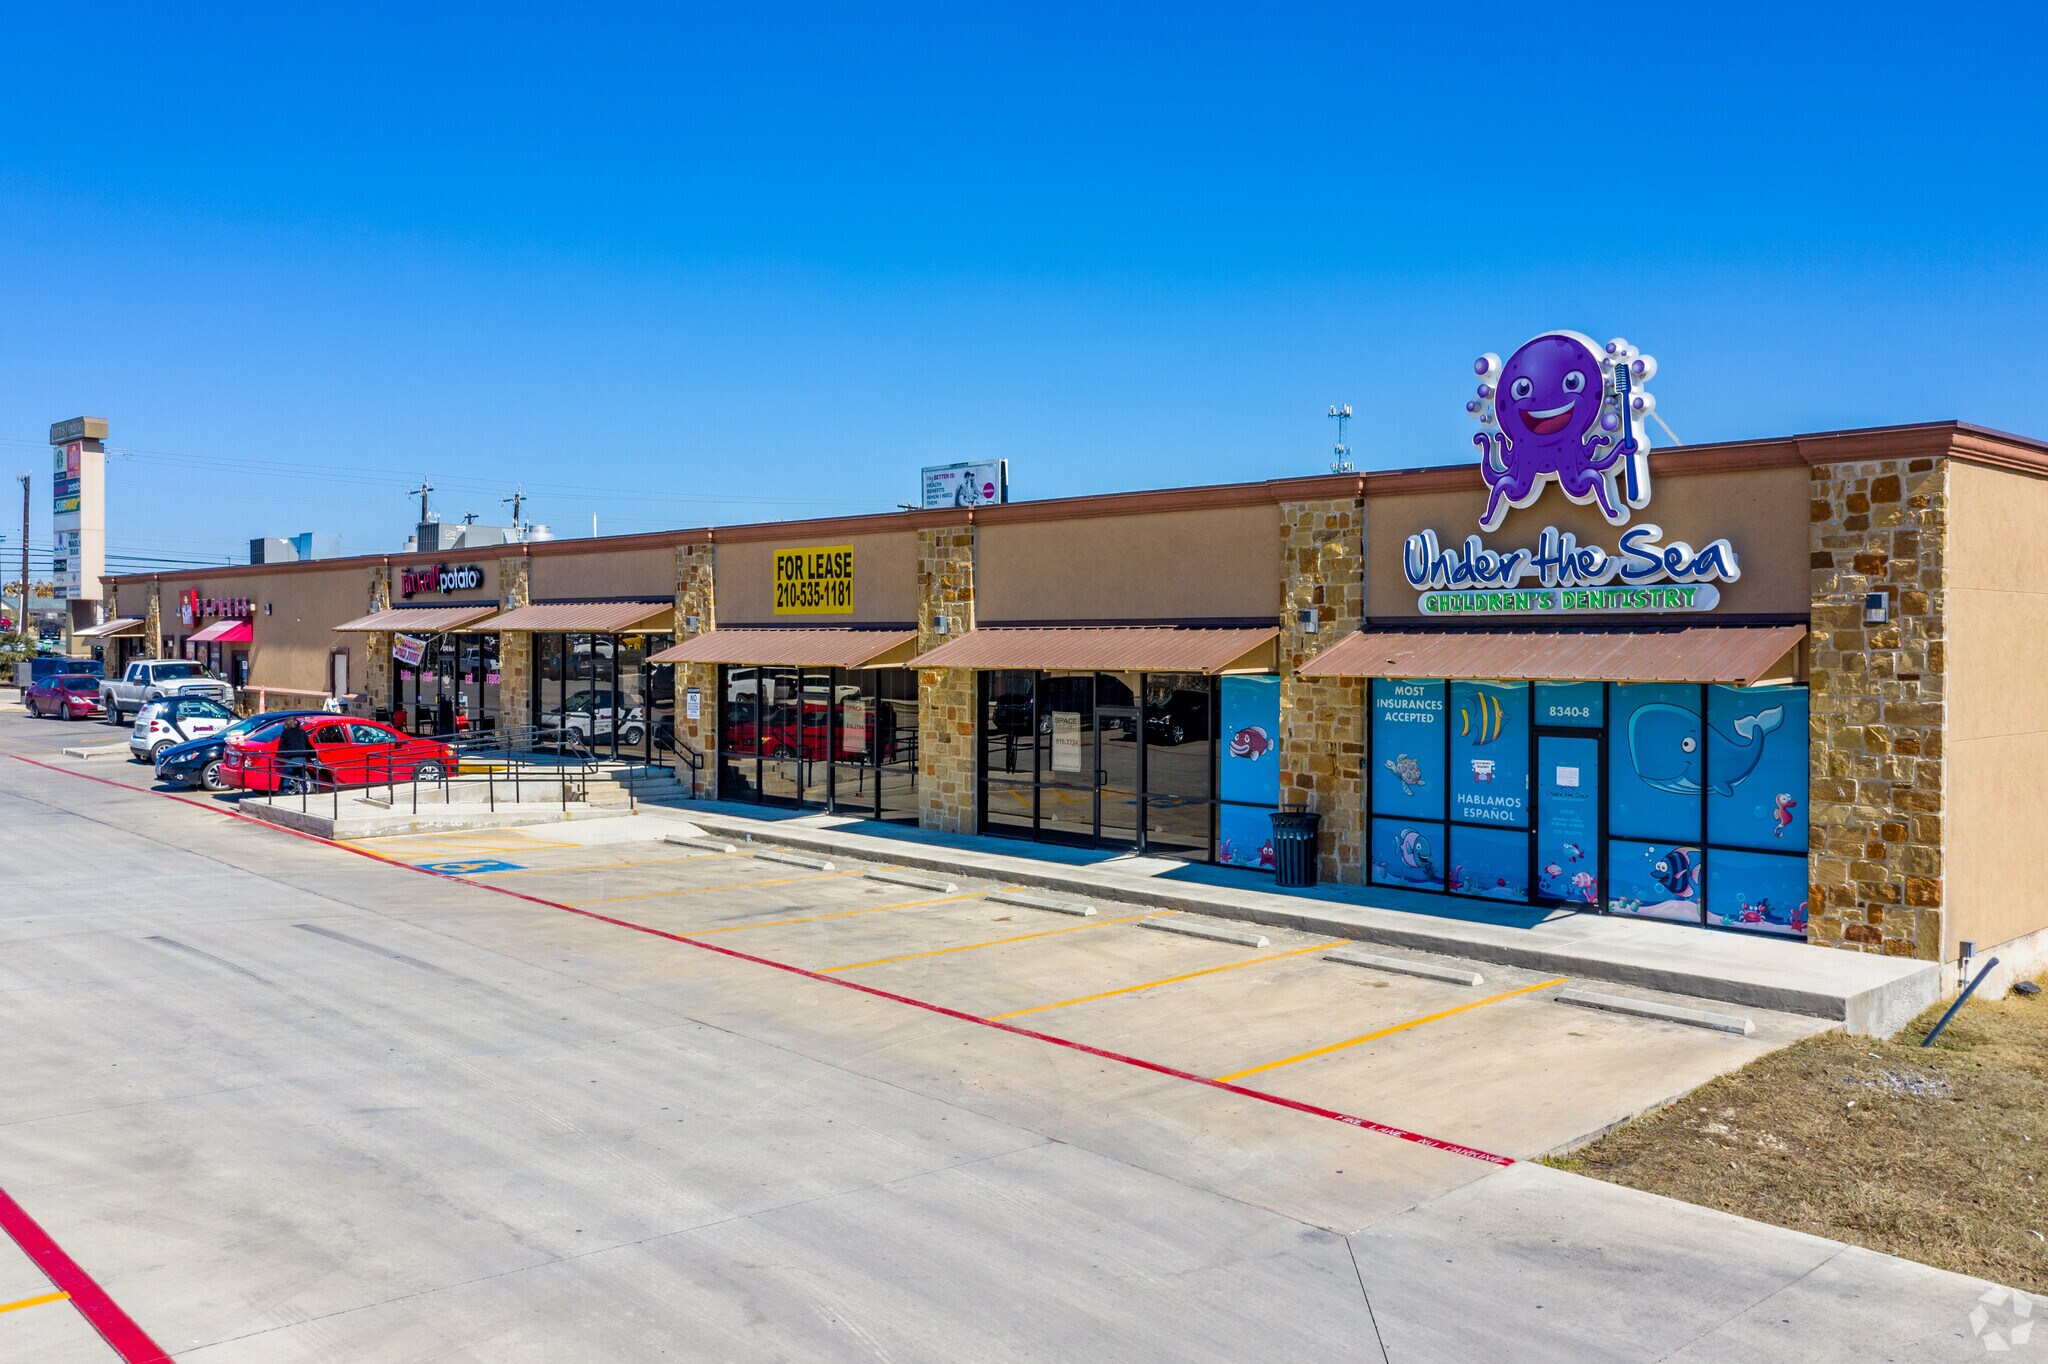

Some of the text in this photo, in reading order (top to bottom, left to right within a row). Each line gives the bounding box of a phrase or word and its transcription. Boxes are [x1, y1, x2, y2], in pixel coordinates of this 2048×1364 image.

[777, 552, 852, 581] FOR LEASE
[1403, 527, 1736, 588] Under the Sea
[440, 566, 477, 594] potato
[777, 580, 851, 607] 210-535-1181
[1424, 586, 1699, 612] CHILDREN'S DENTISTRY
[1394, 686, 1425, 696] MOST
[1376, 698, 1443, 710] INSURANCES
[1549, 706, 1590, 717] 8340-8
[1384, 712, 1434, 723] ACCEPTED
[1457, 793, 1521, 808] HABLAMOS
[1463, 806, 1515, 821] ESPAÑOL
[1335, 1115, 1504, 1164] FIRE LANE NO PARKING
